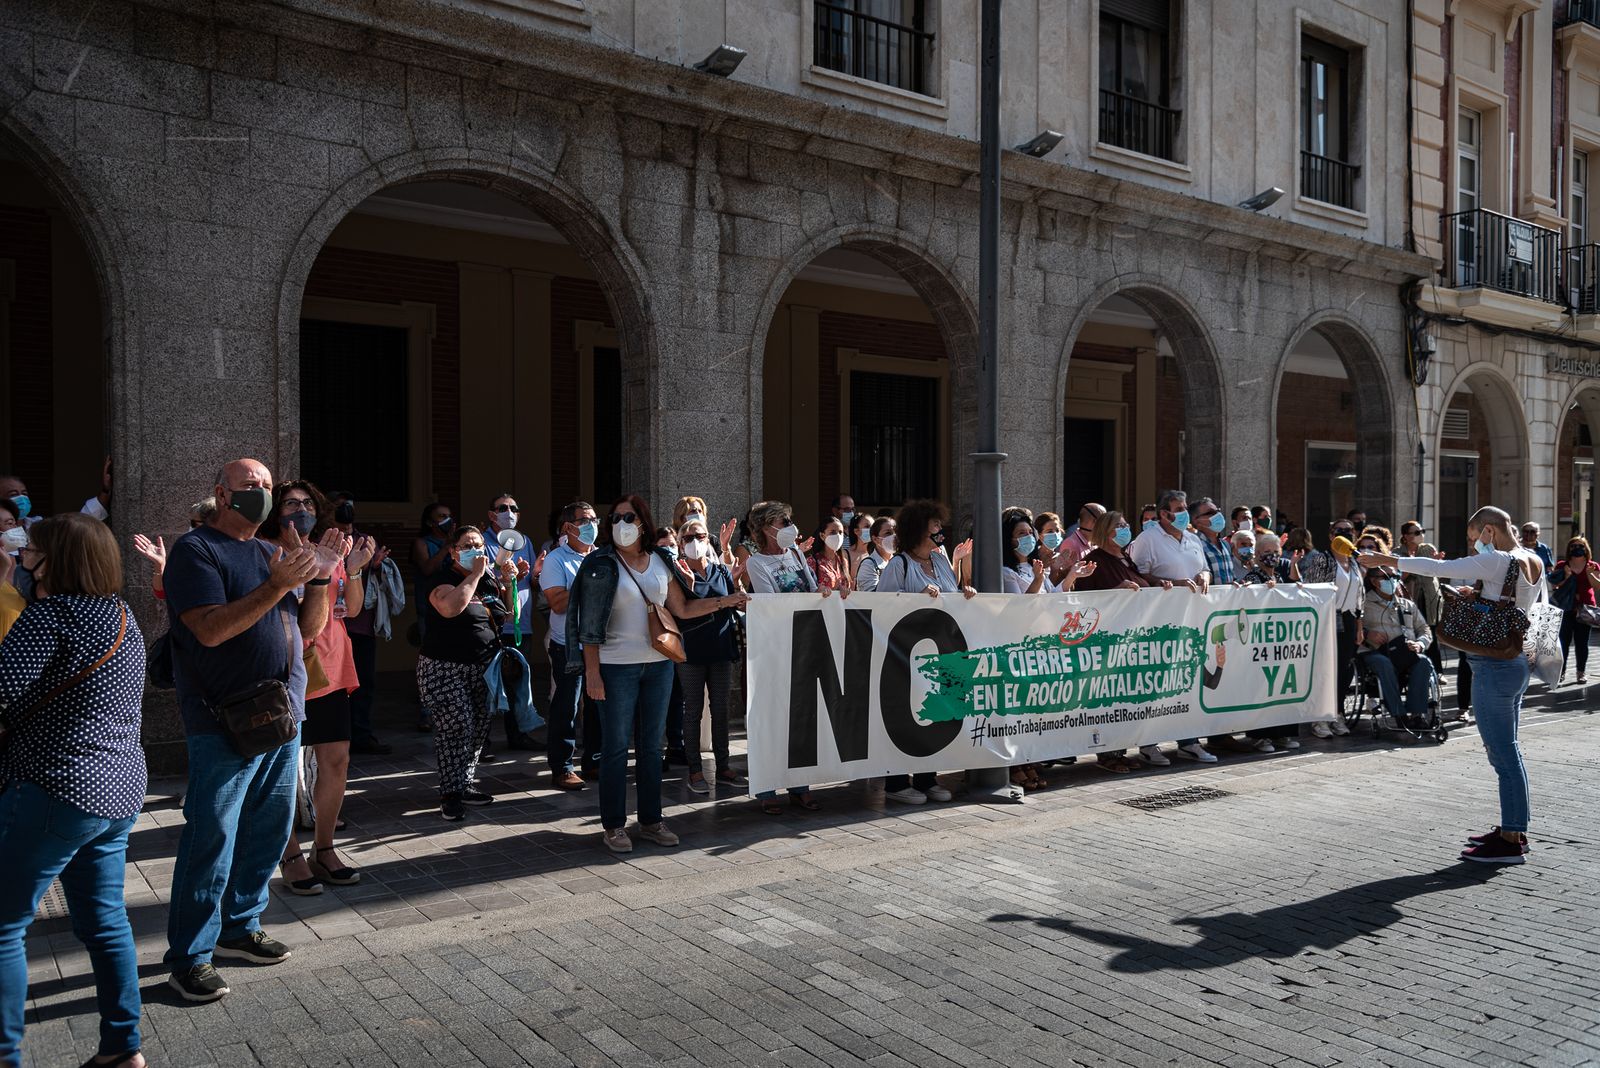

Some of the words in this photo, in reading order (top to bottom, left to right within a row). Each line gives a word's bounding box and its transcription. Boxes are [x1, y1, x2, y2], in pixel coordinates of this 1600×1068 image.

[1552, 355, 1600, 377] Deutsche
[1251, 616, 1312, 644] MÉDICO
[972, 653, 1003, 678] AL
[1008, 648, 1073, 678] CIERRE
[1078, 646, 1102, 671] DE
[1106, 638, 1193, 669] URGENCIAS
[1252, 647, 1268, 662] 24
[1274, 643, 1309, 661] HORAS
[787, 608, 969, 769] NO
[973, 683, 998, 711] EN
[1004, 682, 1021, 709] EL
[1025, 674, 1073, 707] ROCÍO
[1077, 677, 1091, 702] Y
[1089, 664, 1192, 699] MATALASCAÑAS
[1262, 664, 1297, 697] YA
